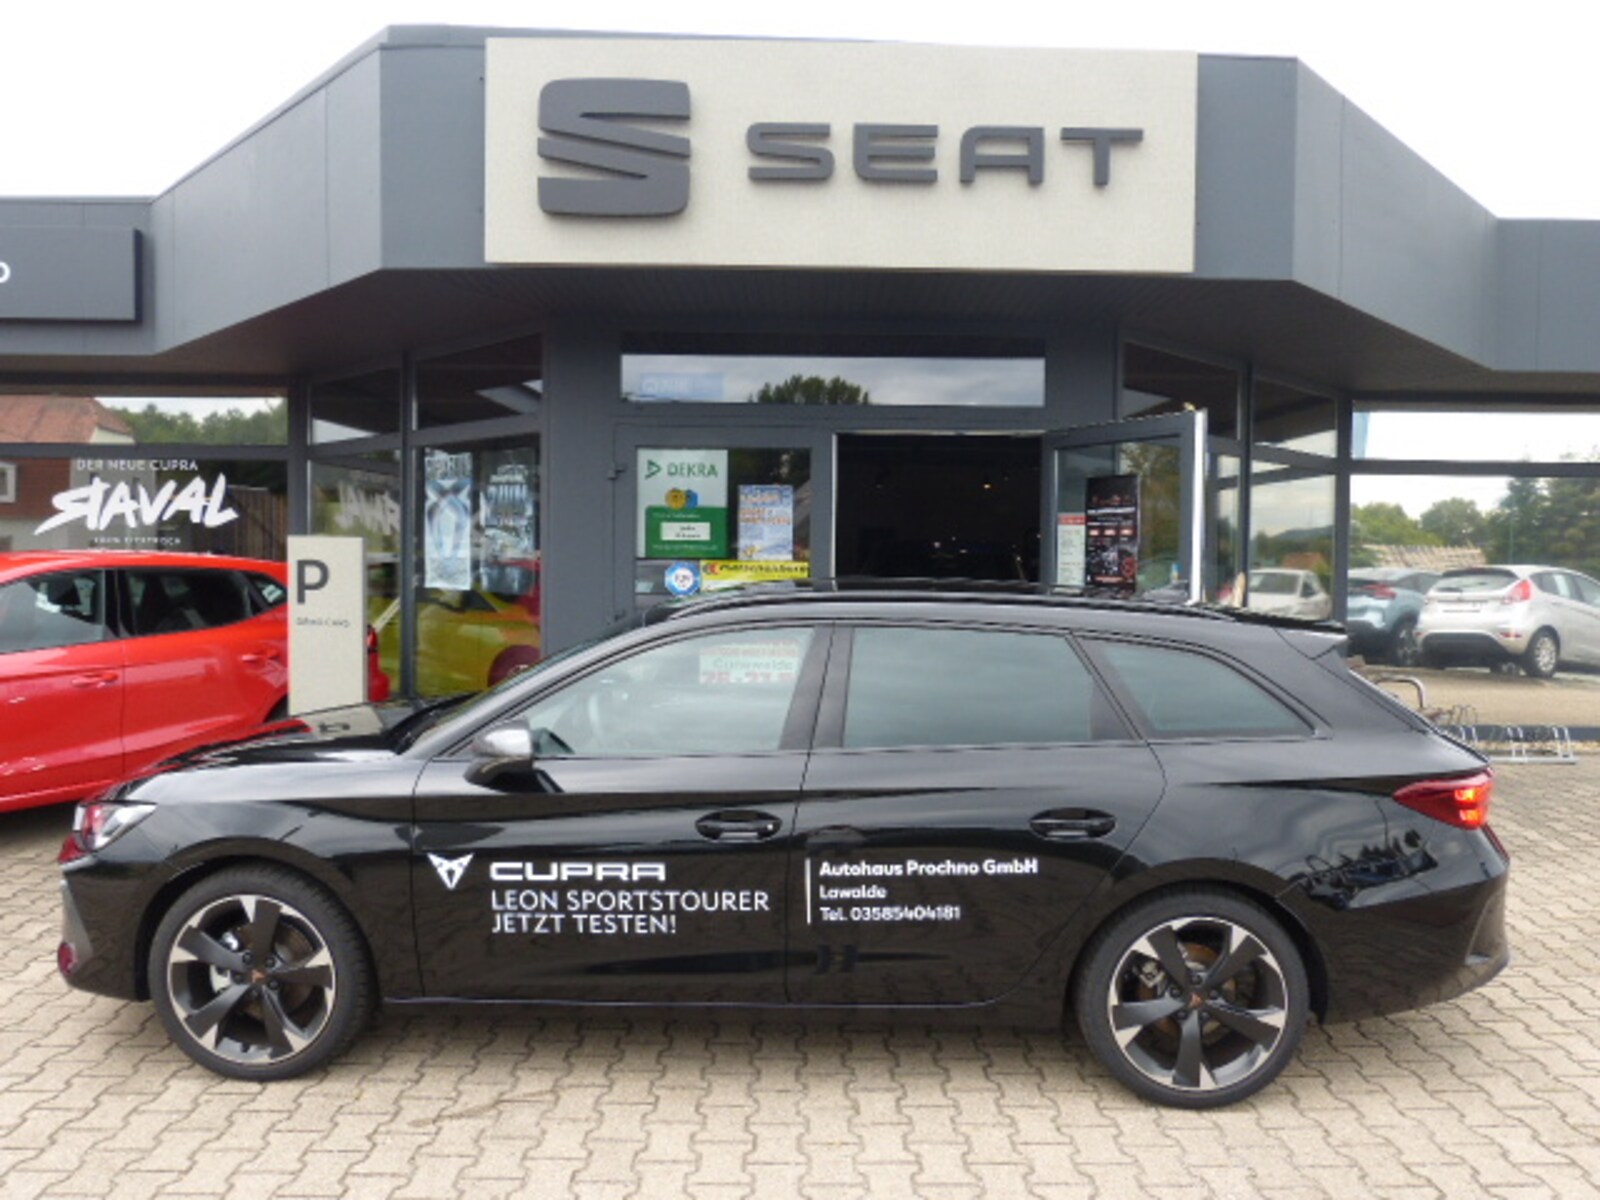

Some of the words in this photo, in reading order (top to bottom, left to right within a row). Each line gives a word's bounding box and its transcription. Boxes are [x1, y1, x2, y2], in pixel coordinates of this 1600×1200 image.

[746, 122, 1143, 186] SEAT
[76, 459, 104, 471] DER
[108, 459, 146, 471] NEUE
[149, 459, 199, 471] CUPRA
[667, 462, 718, 478] DEKRA
[297, 559, 329, 604] P
[490, 862, 666, 881] CUPRA
[819, 861, 903, 877] Autohaus
[906, 859, 980, 876] Prochno
[983, 858, 1038, 874] GmbH
[491, 890, 558, 911] LEON
[566, 890, 770, 912] SPORTSTOURER
[819, 885, 887, 899] Lawalde
[819, 906, 848, 921] Tel.
[851, 905, 961, 921] 03585404181
[492, 914, 566, 934] JETZT
[572, 914, 677, 934] TESTEN!
